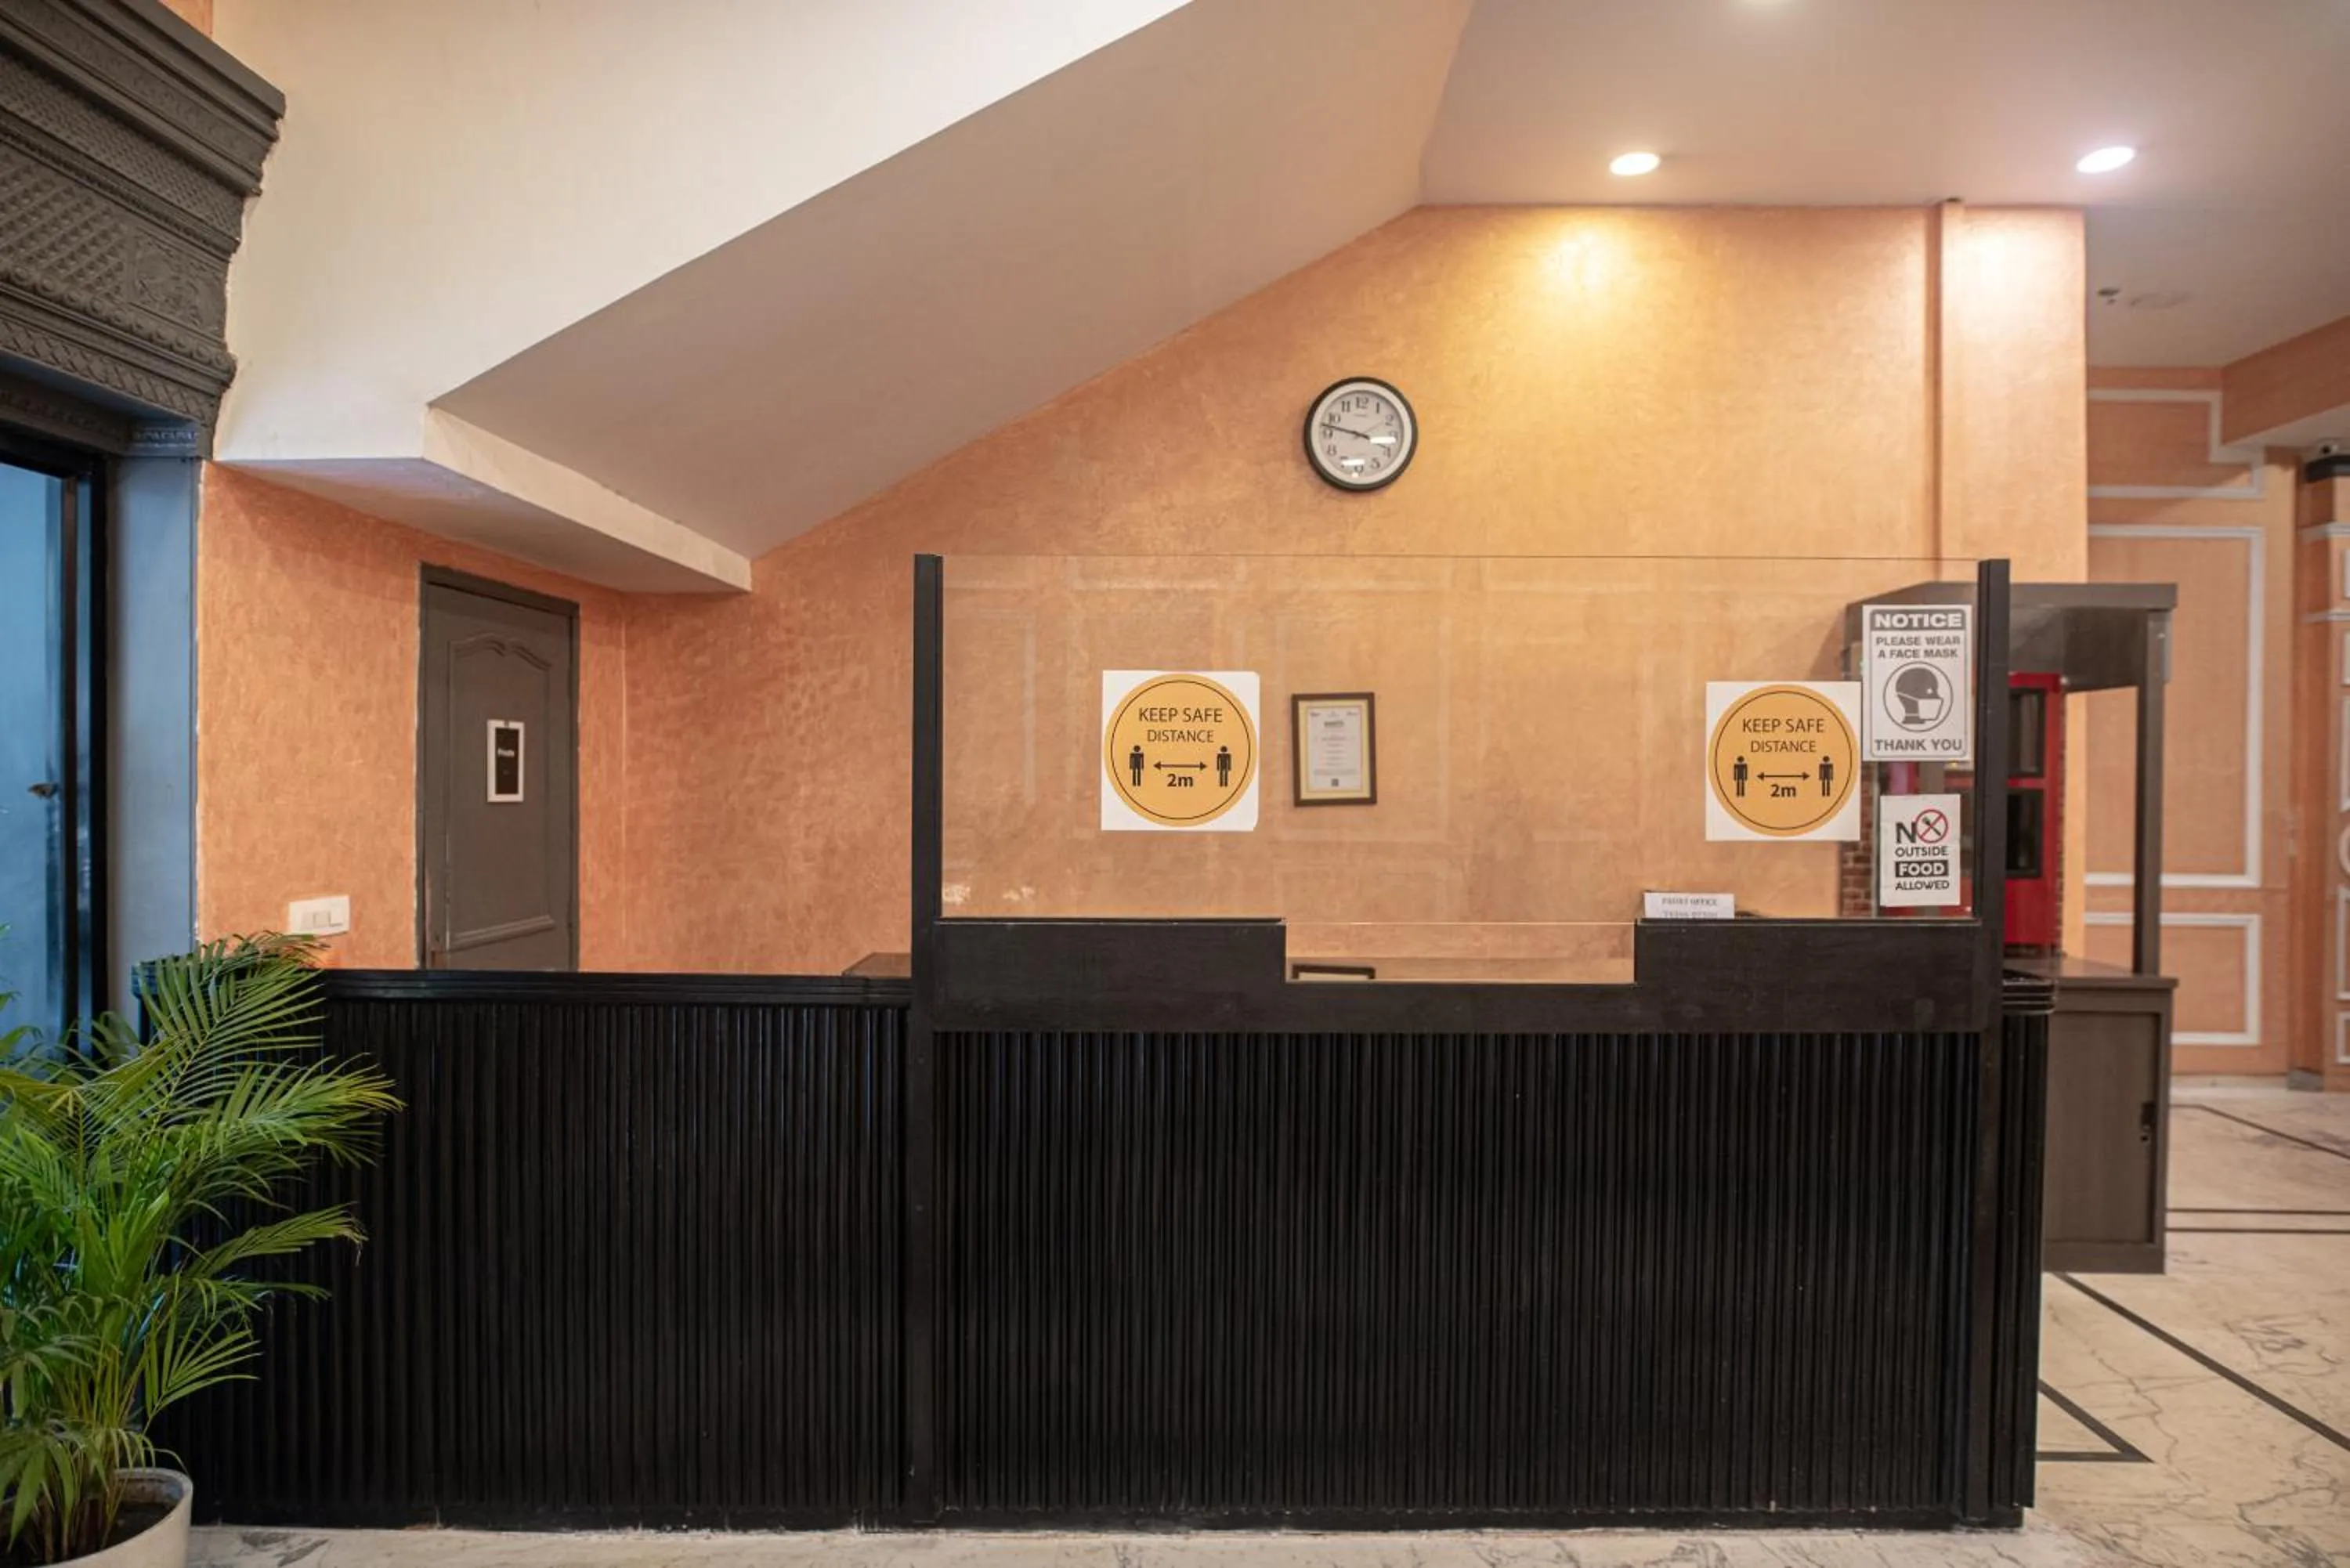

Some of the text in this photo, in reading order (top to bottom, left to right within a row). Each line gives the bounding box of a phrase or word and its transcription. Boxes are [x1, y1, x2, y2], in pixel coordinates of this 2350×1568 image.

[1341, 400, 1350, 413] 11
[1356, 396, 1368, 409] 12
[1329, 414, 1341, 424] 10
[1385, 414, 1394, 427] 2
[1875, 612, 1962, 628] NOTICE
[1876, 635, 1961, 646] PLEASE WEAR
[1878, 649, 1958, 659] A FACE MASK
[1138, 707, 1223, 723] KEEP SAFE
[1742, 718, 1824, 733] KEEP SAFE
[1147, 729, 1214, 742] DISTANCE
[1750, 740, 1817, 753] DISTANCE
[1875, 739, 1962, 751] THANK YOU
[1166, 773, 1194, 787] 2m
[1770, 784, 1797, 798] 2m
[1895, 846, 1949, 857] OUTSIDE
[1899, 862, 1945, 876] FOOD
[1895, 880, 1950, 891] ALLOWED
